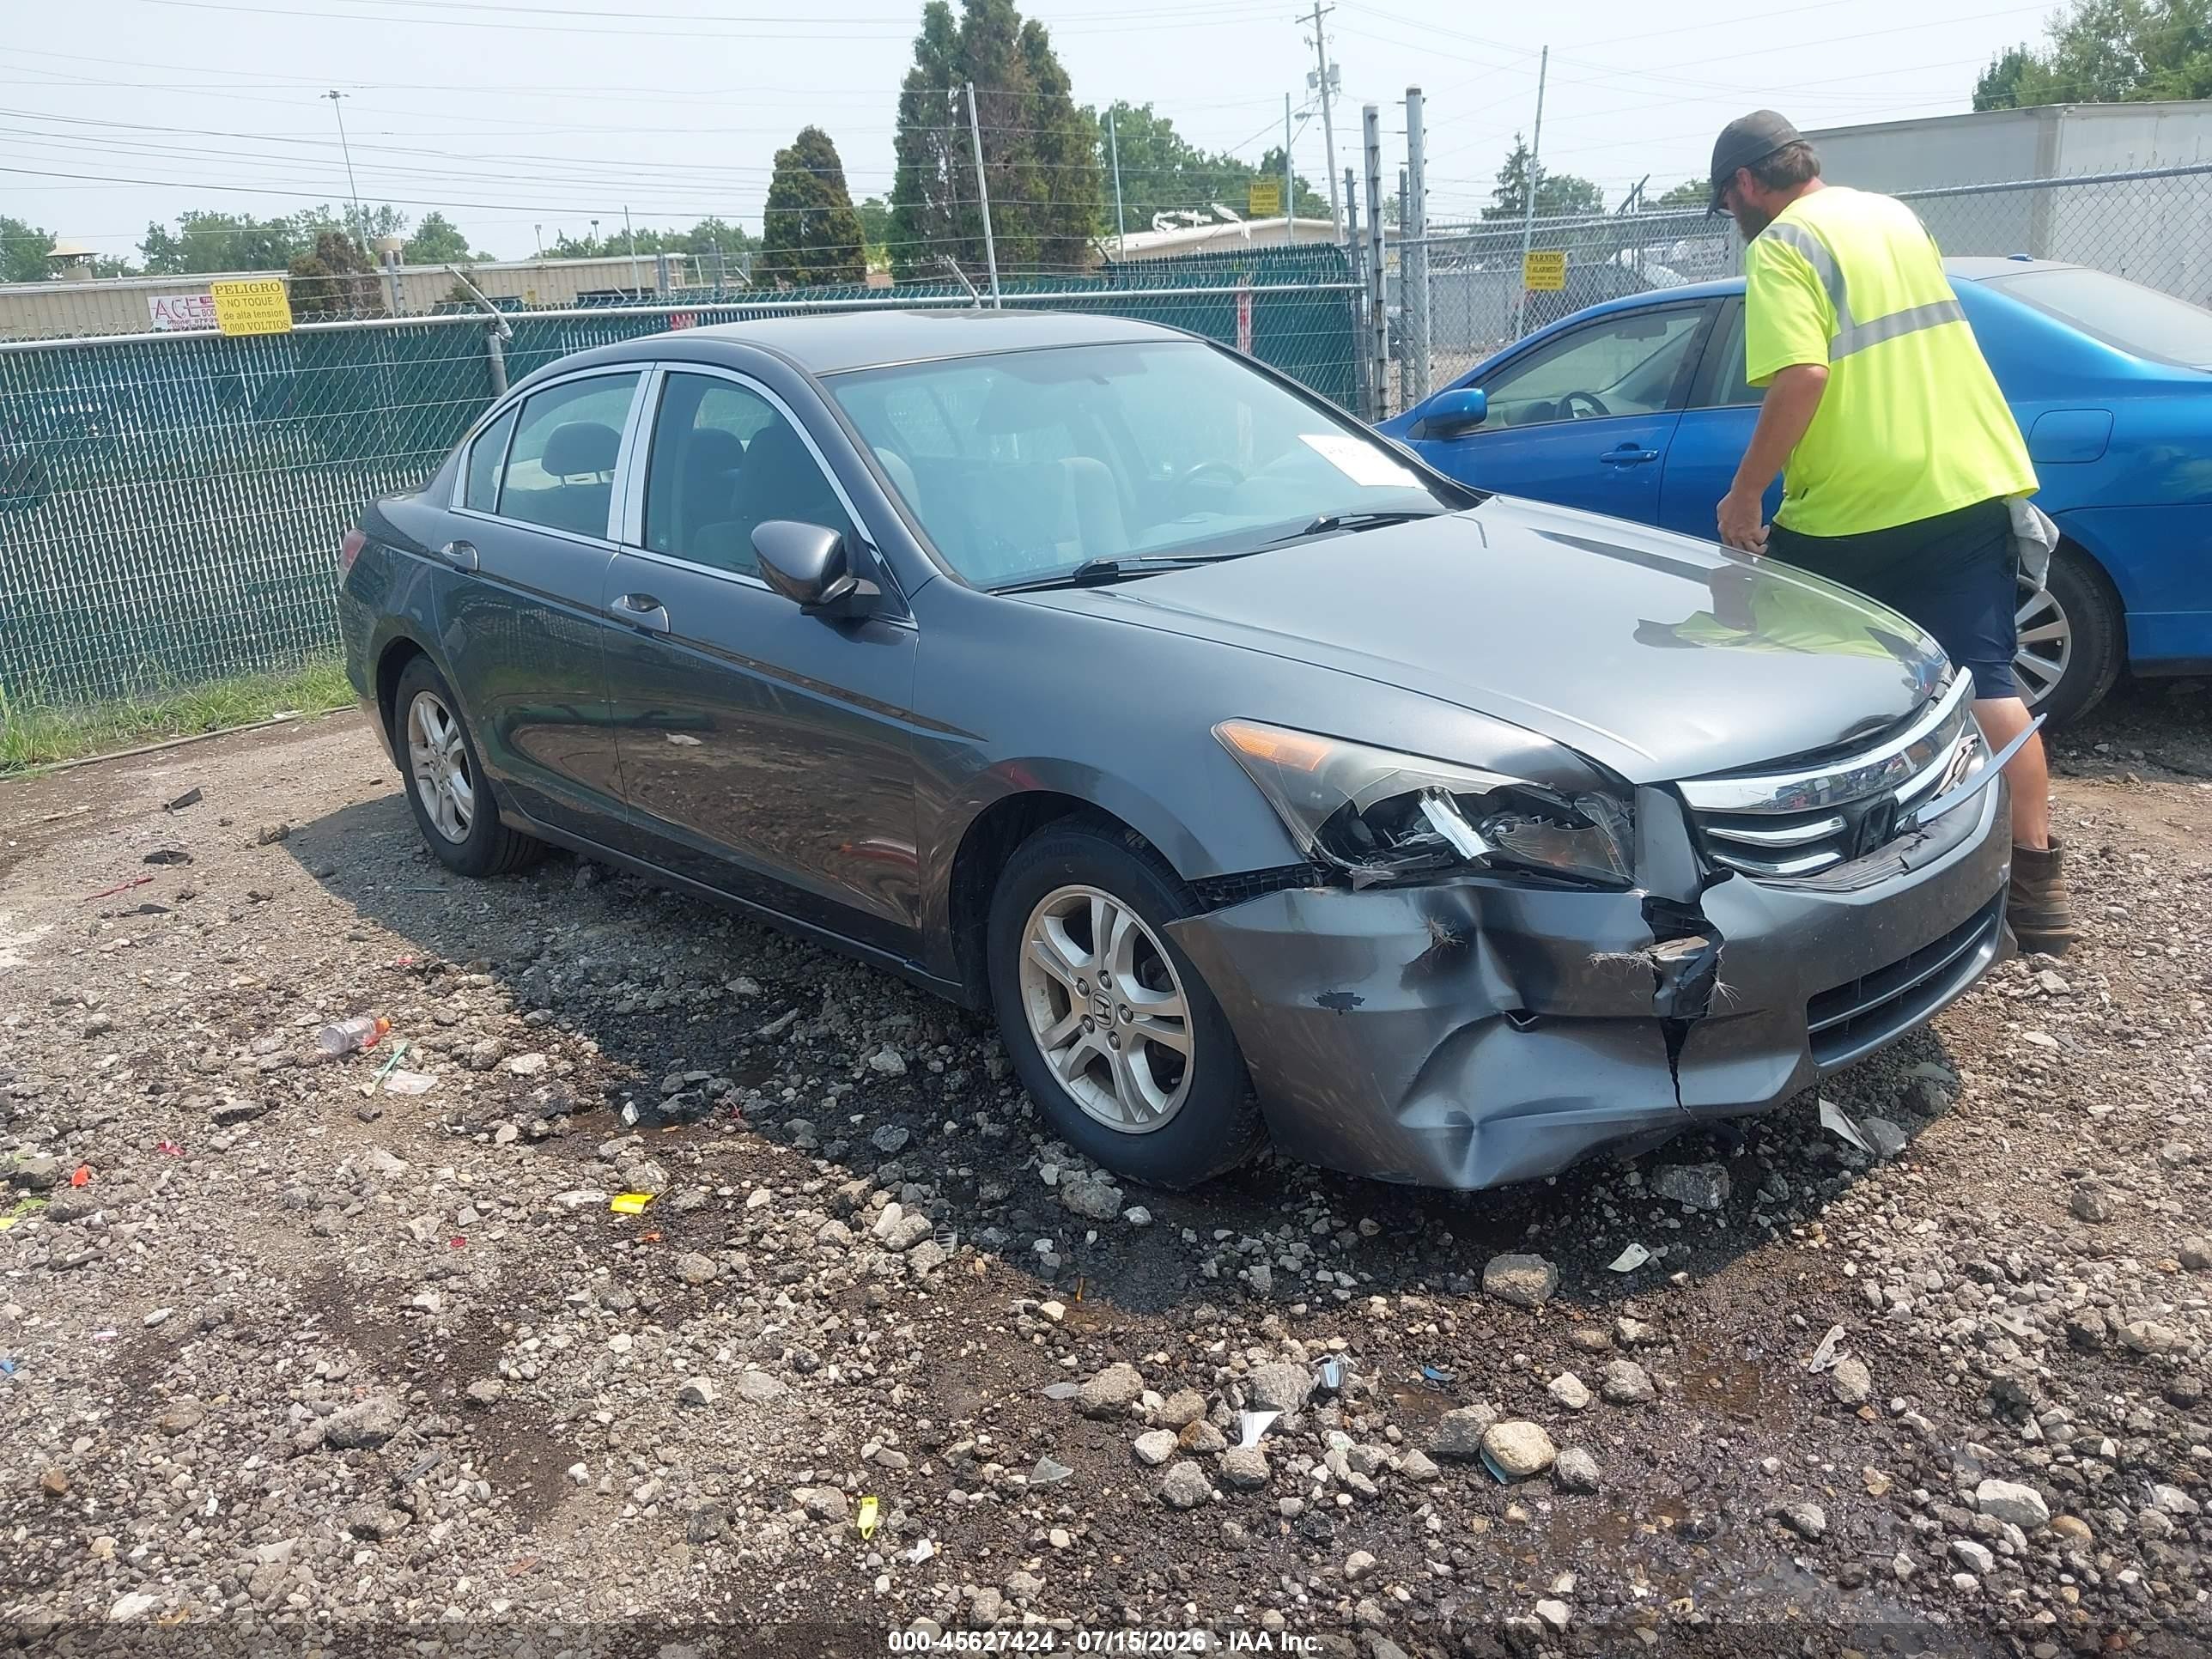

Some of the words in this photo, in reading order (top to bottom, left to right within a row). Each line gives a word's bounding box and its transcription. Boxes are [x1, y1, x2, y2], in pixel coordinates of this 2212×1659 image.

[214, 283, 280, 295] PELIGRO
[227, 299, 240, 307] NO
[242, 297, 274, 307] TOQUE
[155, 297, 200, 319] ACE
[224, 311, 234, 319] de
[237, 310, 252, 319] alta
[253, 310, 284, 319] tension
[247, 320, 289, 331] VOLTIOS
